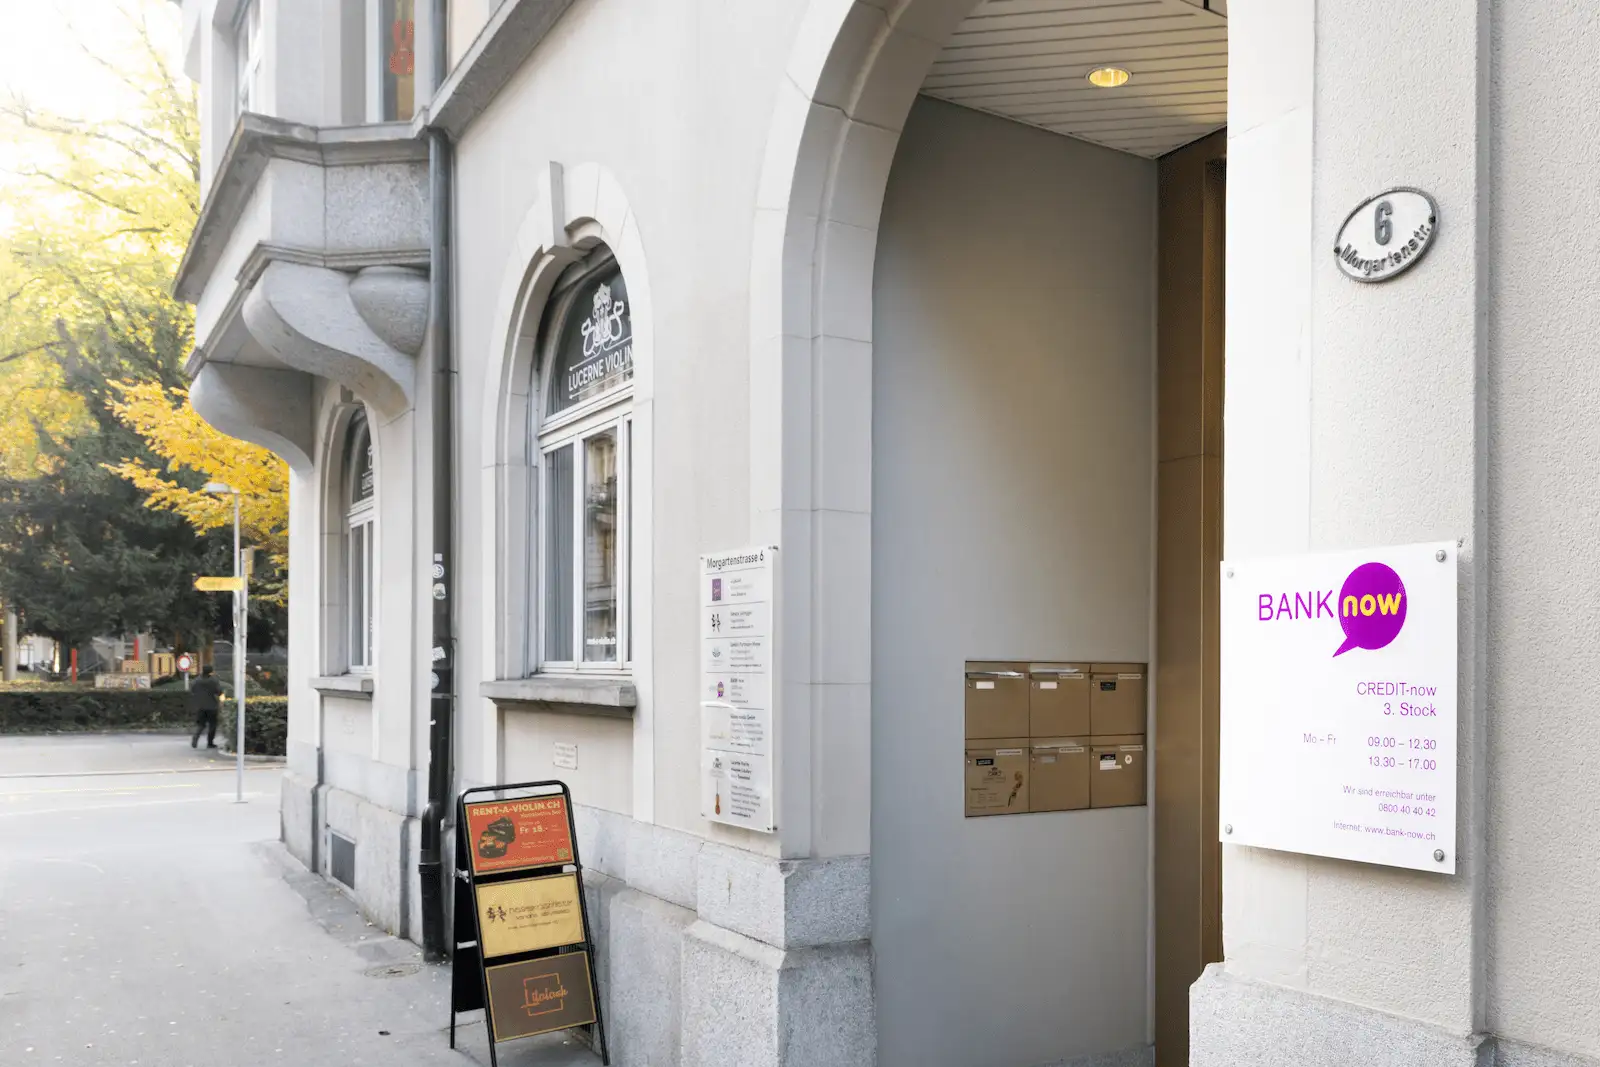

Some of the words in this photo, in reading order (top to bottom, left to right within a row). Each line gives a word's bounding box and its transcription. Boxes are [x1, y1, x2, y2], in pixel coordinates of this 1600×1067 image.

[1374, 200, 1393, 246] 6
[1340, 224, 1431, 276] Morgartenstr.
[568, 358, 604, 391] LUCERNE
[706, 555, 758, 571] Morgartenstrasse
[1258, 588, 1335, 621] BANK
[1343, 593, 1402, 617] now
[1356, 681, 1437, 697] CREDIT-now
[1383, 702, 1395, 716] 3.
[1399, 702, 1437, 717] Stock
[1303, 733, 1317, 744] Mo
[1327, 734, 1337, 745] Fr
[1367, 736, 1396, 748] 09.00
[1408, 738, 1436, 750] 12.30
[1368, 756, 1396, 768] 13.30
[1408, 759, 1436, 771] 17.00
[1342, 785, 1356, 794] Wir
[1358, 787, 1373, 797] sind
[1374, 789, 1414, 800] erreichbar
[1416, 793, 1436, 802] unter
[472, 801, 561, 817] RENT-A-VIOLIN.CH
[1378, 803, 1398, 813] 0800
[1400, 805, 1411, 815] 40
[1412, 806, 1424, 816] 40
[1425, 808, 1436, 817] 42
[1333, 820, 1362, 833] Internet:
[1364, 826, 1436, 841] www.bank-now.ch
